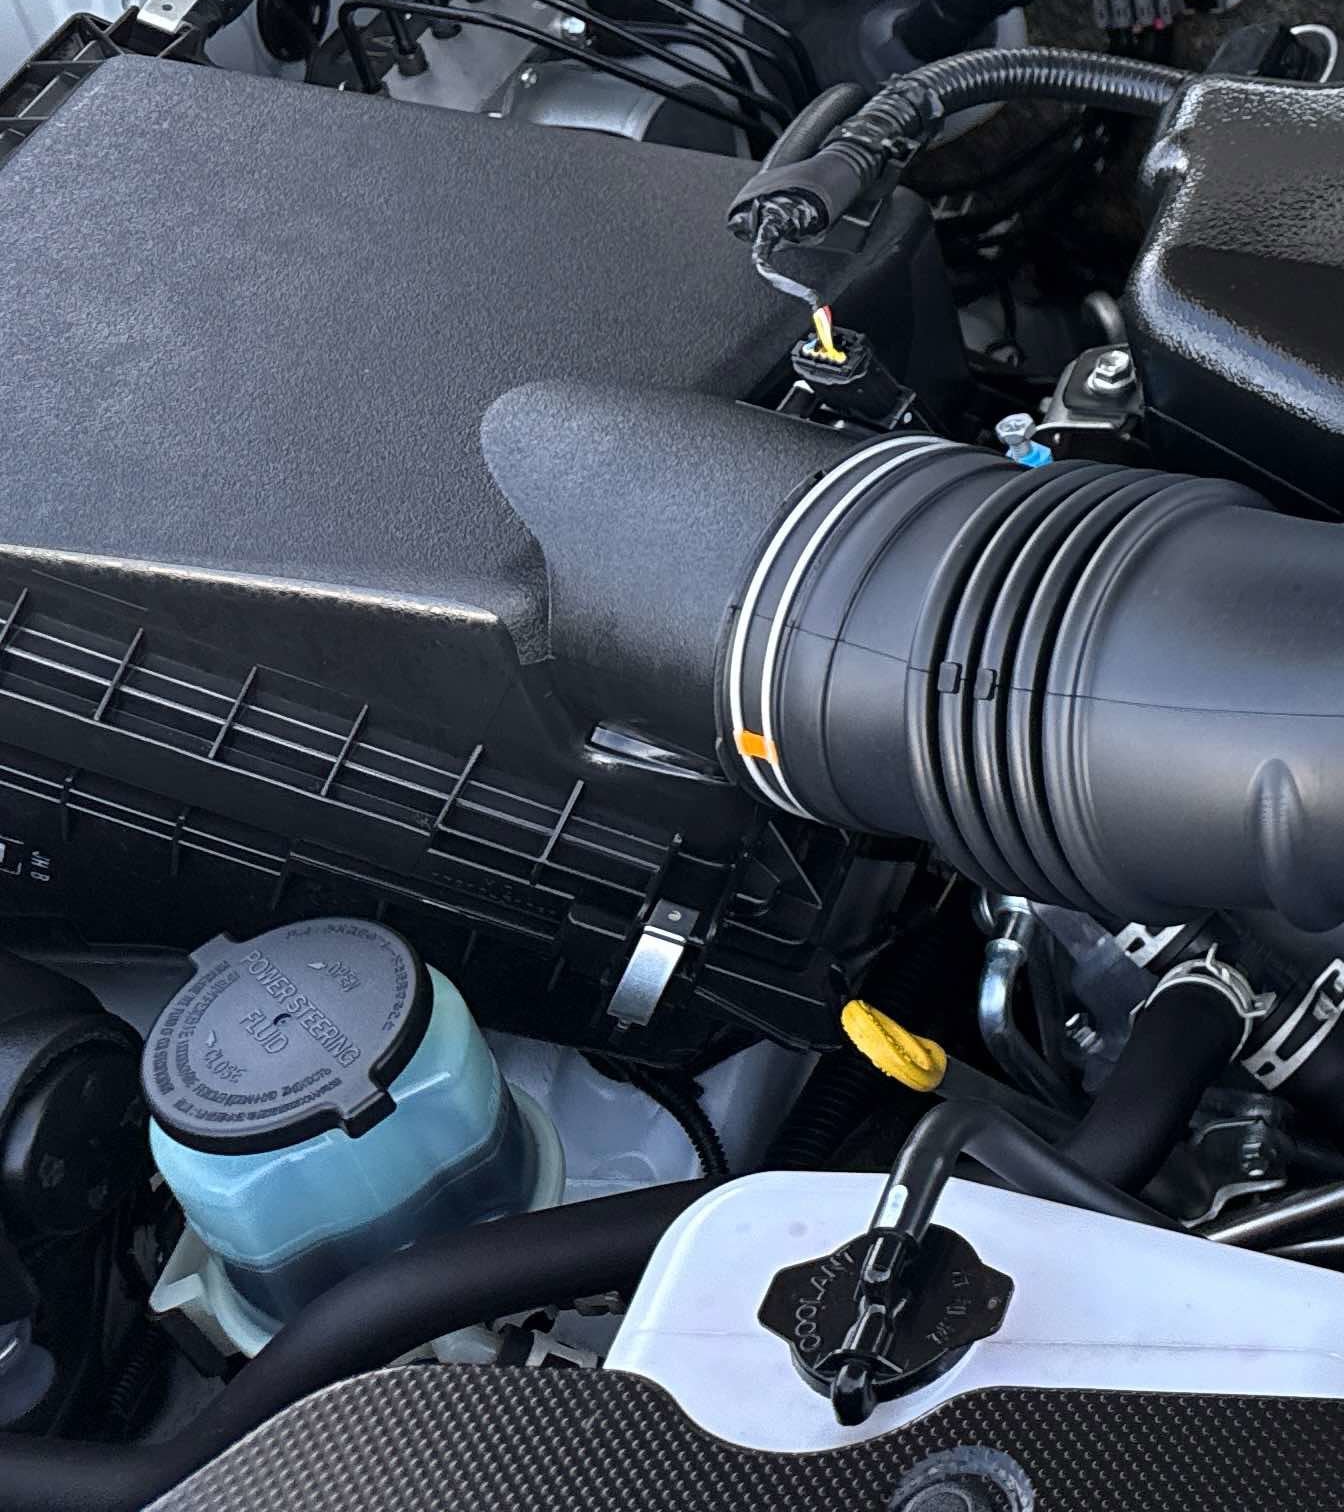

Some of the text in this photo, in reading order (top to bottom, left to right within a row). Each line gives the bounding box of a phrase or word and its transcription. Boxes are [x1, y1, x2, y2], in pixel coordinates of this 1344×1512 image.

[327, 959, 361, 993] OPEN
[239, 1008, 290, 1055] FLUID
[240, 948, 299, 1004] POWER
[286, 993, 362, 1069] STEERING
[204, 1048, 248, 1085] CLOSE
[795, 1244, 855, 1353] COOLANT
